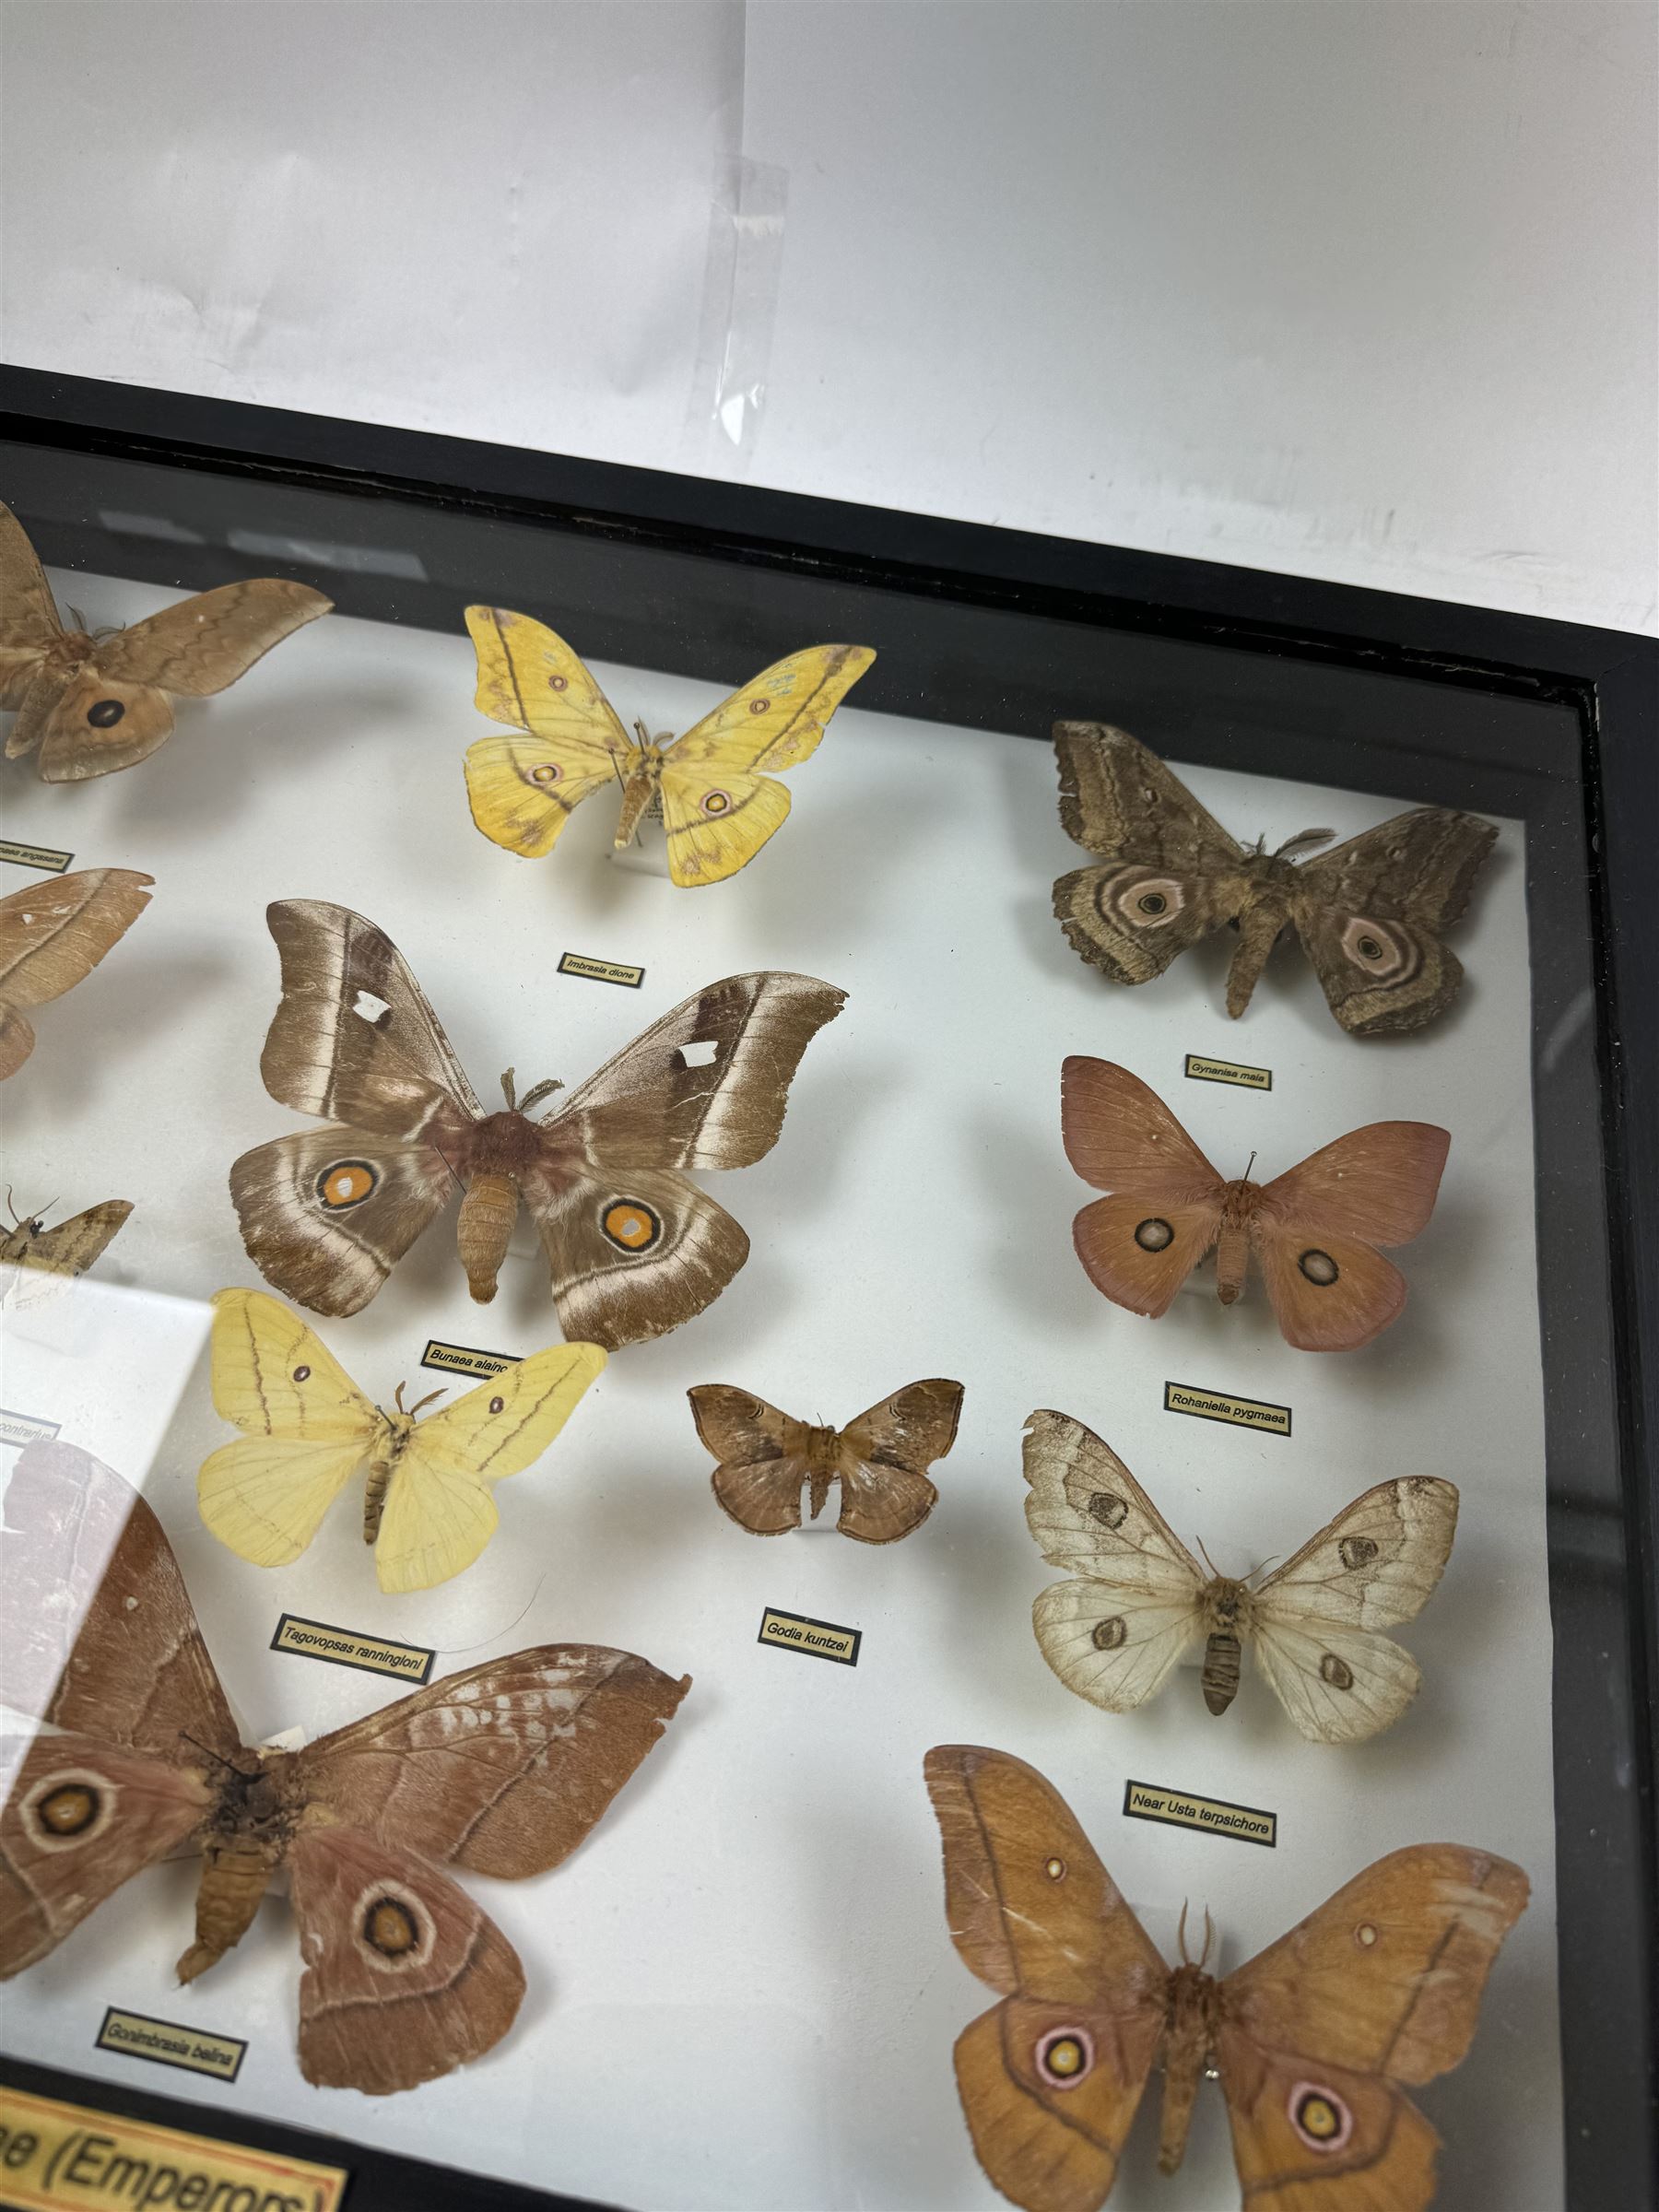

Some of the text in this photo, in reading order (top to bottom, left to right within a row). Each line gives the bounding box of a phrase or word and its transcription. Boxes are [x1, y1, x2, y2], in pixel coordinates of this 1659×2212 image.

[567, 959, 635, 979] Imbrasia dione
[1192, 1063, 1265, 1082] Gynanisa maia
[429, 1348, 509, 1373] Bunaea alaino
[1171, 1393, 1287, 1424] Rohaniella pygmaea
[767, 1622, 850, 1652] Godia kuntzei
[1133, 1793, 1270, 1834] Near Usta terpsichore
